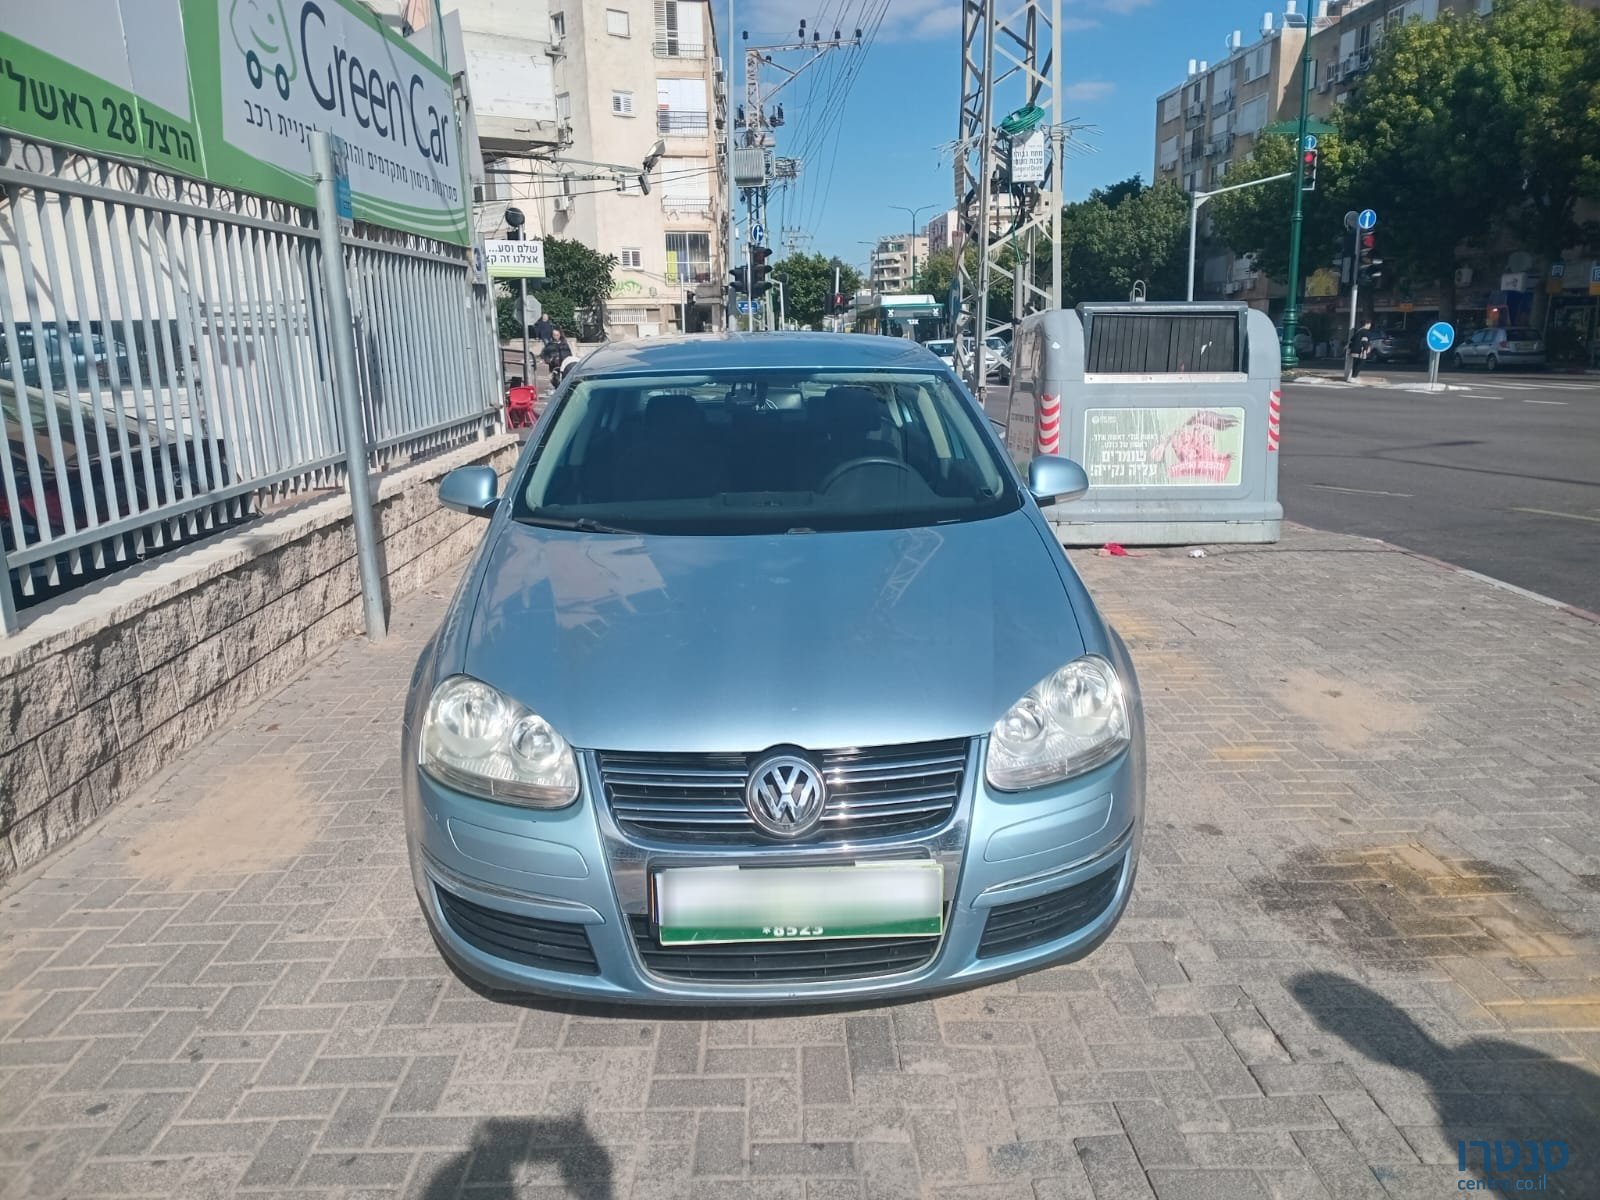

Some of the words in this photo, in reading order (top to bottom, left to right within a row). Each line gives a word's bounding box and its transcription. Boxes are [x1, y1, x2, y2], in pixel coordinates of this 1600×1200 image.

[102, 97, 137, 145] 28
[244, 100, 273, 131] רכב
[140, 107, 196, 163] הרצל
[278, 113, 317, 152] קניית
[368, 151, 408, 184] מתקדמים
[410, 168, 430, 193] מימון
[517, 244, 538, 253] שלם
[501, 255, 510, 263] זה
[513, 254, 538, 264] אצלנו
[1102, 450, 1147, 462] שומרים
[1090, 464, 1125, 478] נקייה!
[1128, 462, 1158, 477] עליה
